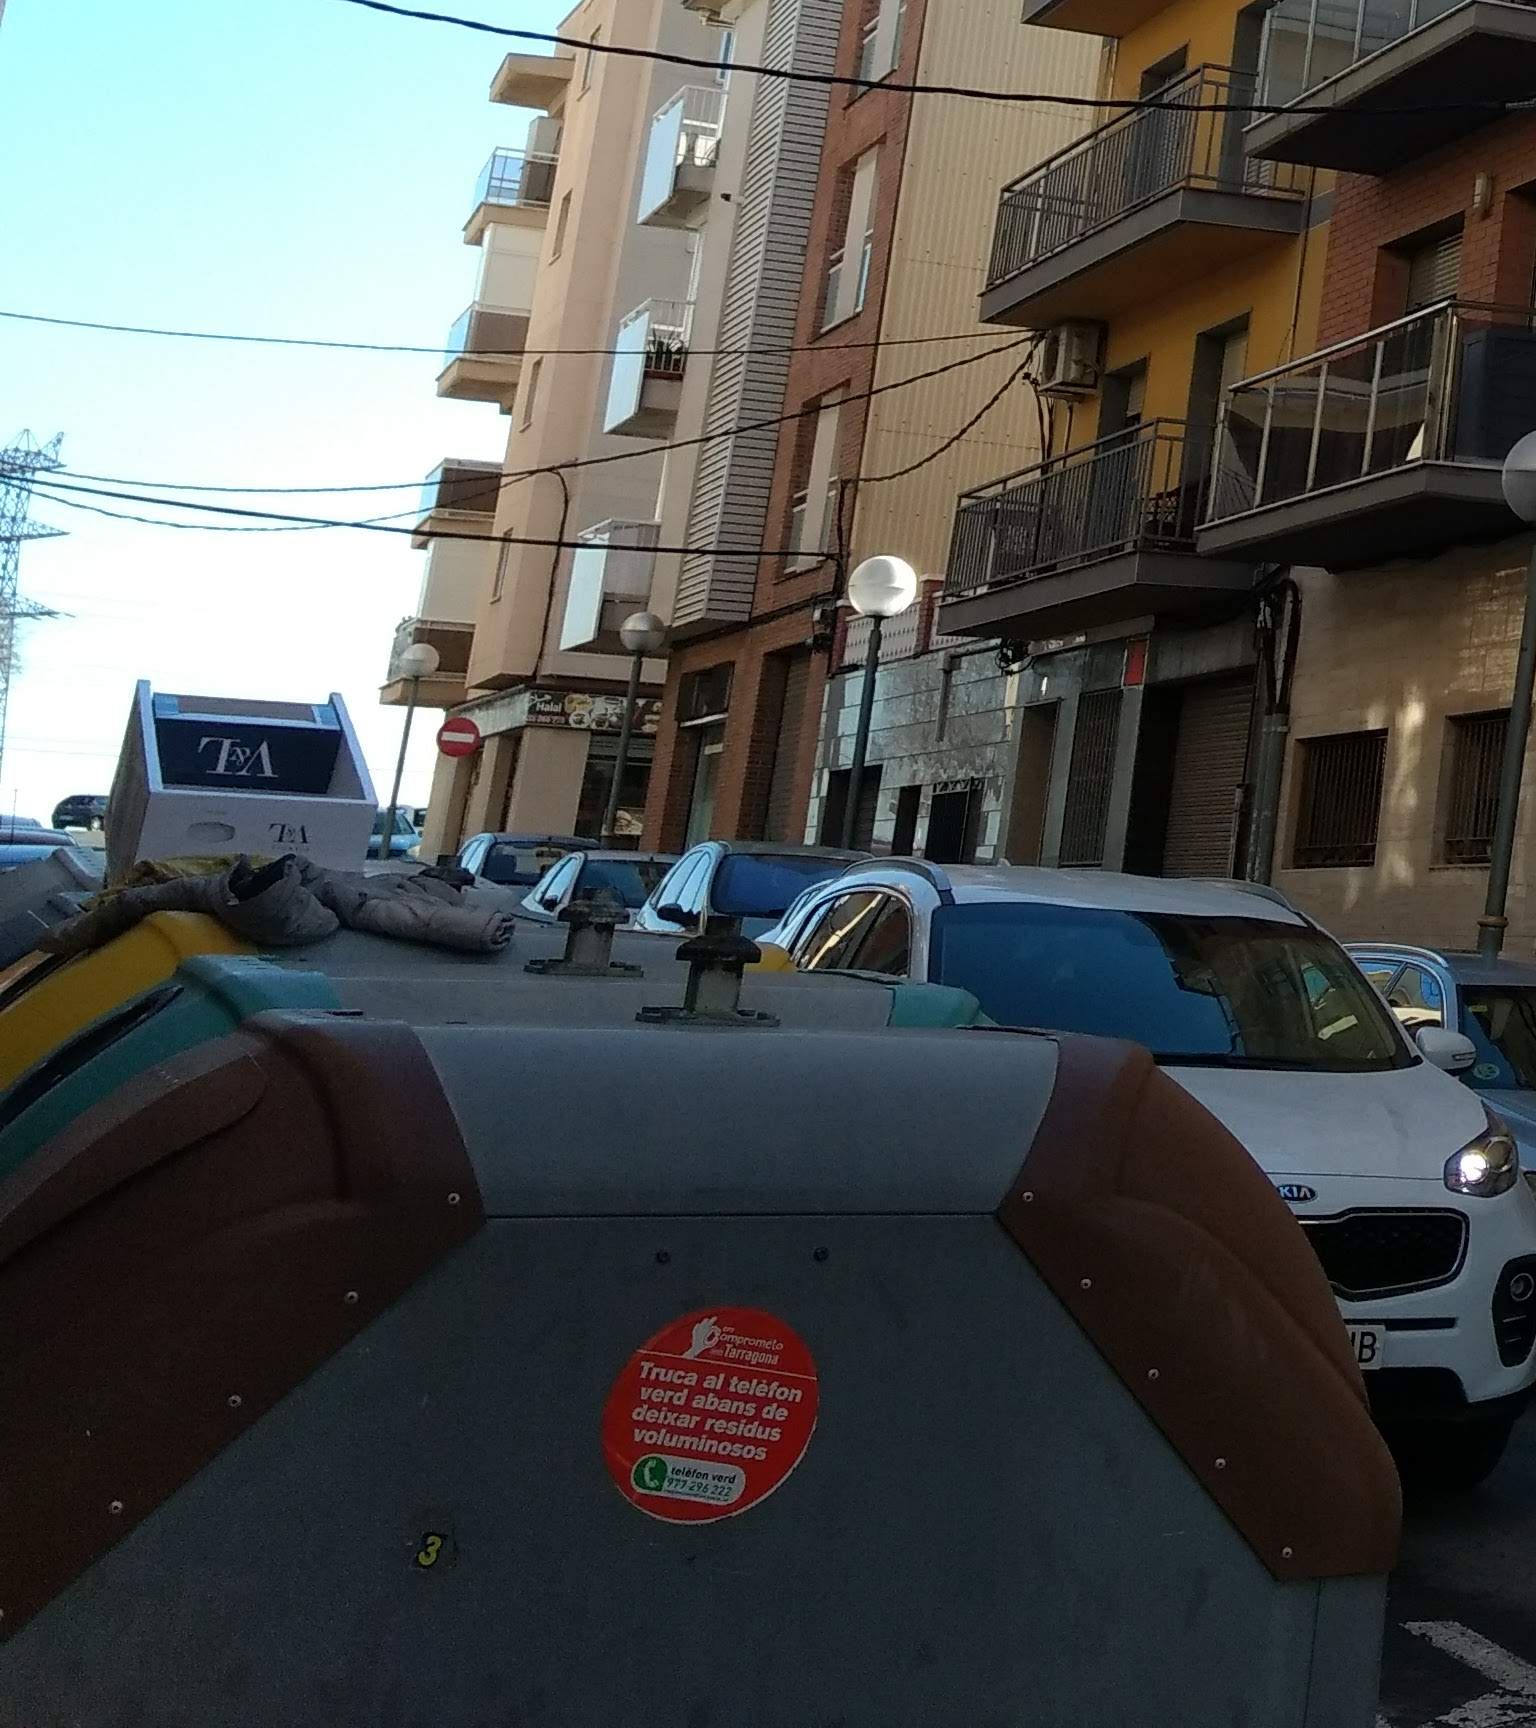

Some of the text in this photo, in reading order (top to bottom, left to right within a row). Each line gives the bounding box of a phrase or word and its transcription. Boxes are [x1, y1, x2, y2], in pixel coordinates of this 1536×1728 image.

[1279, 1186, 1312, 1198] KIA
[724, 1344, 780, 1365] Tarragona
[1351, 1330, 1378, 1364] B
[639, 1361, 698, 1386] Truca
[703, 1371, 725, 1391] al
[640, 1386, 789, 1422] verd abans de
[631, 1403, 782, 1441] deixar residus
[633, 1427, 768, 1462] voluminosos
[667, 1477, 687, 1490] 977
[688, 1481, 710, 1493] 296
[711, 1485, 732, 1497] 222
[712, 1473, 737, 1484] verd
[418, 1535, 442, 1566] 3
